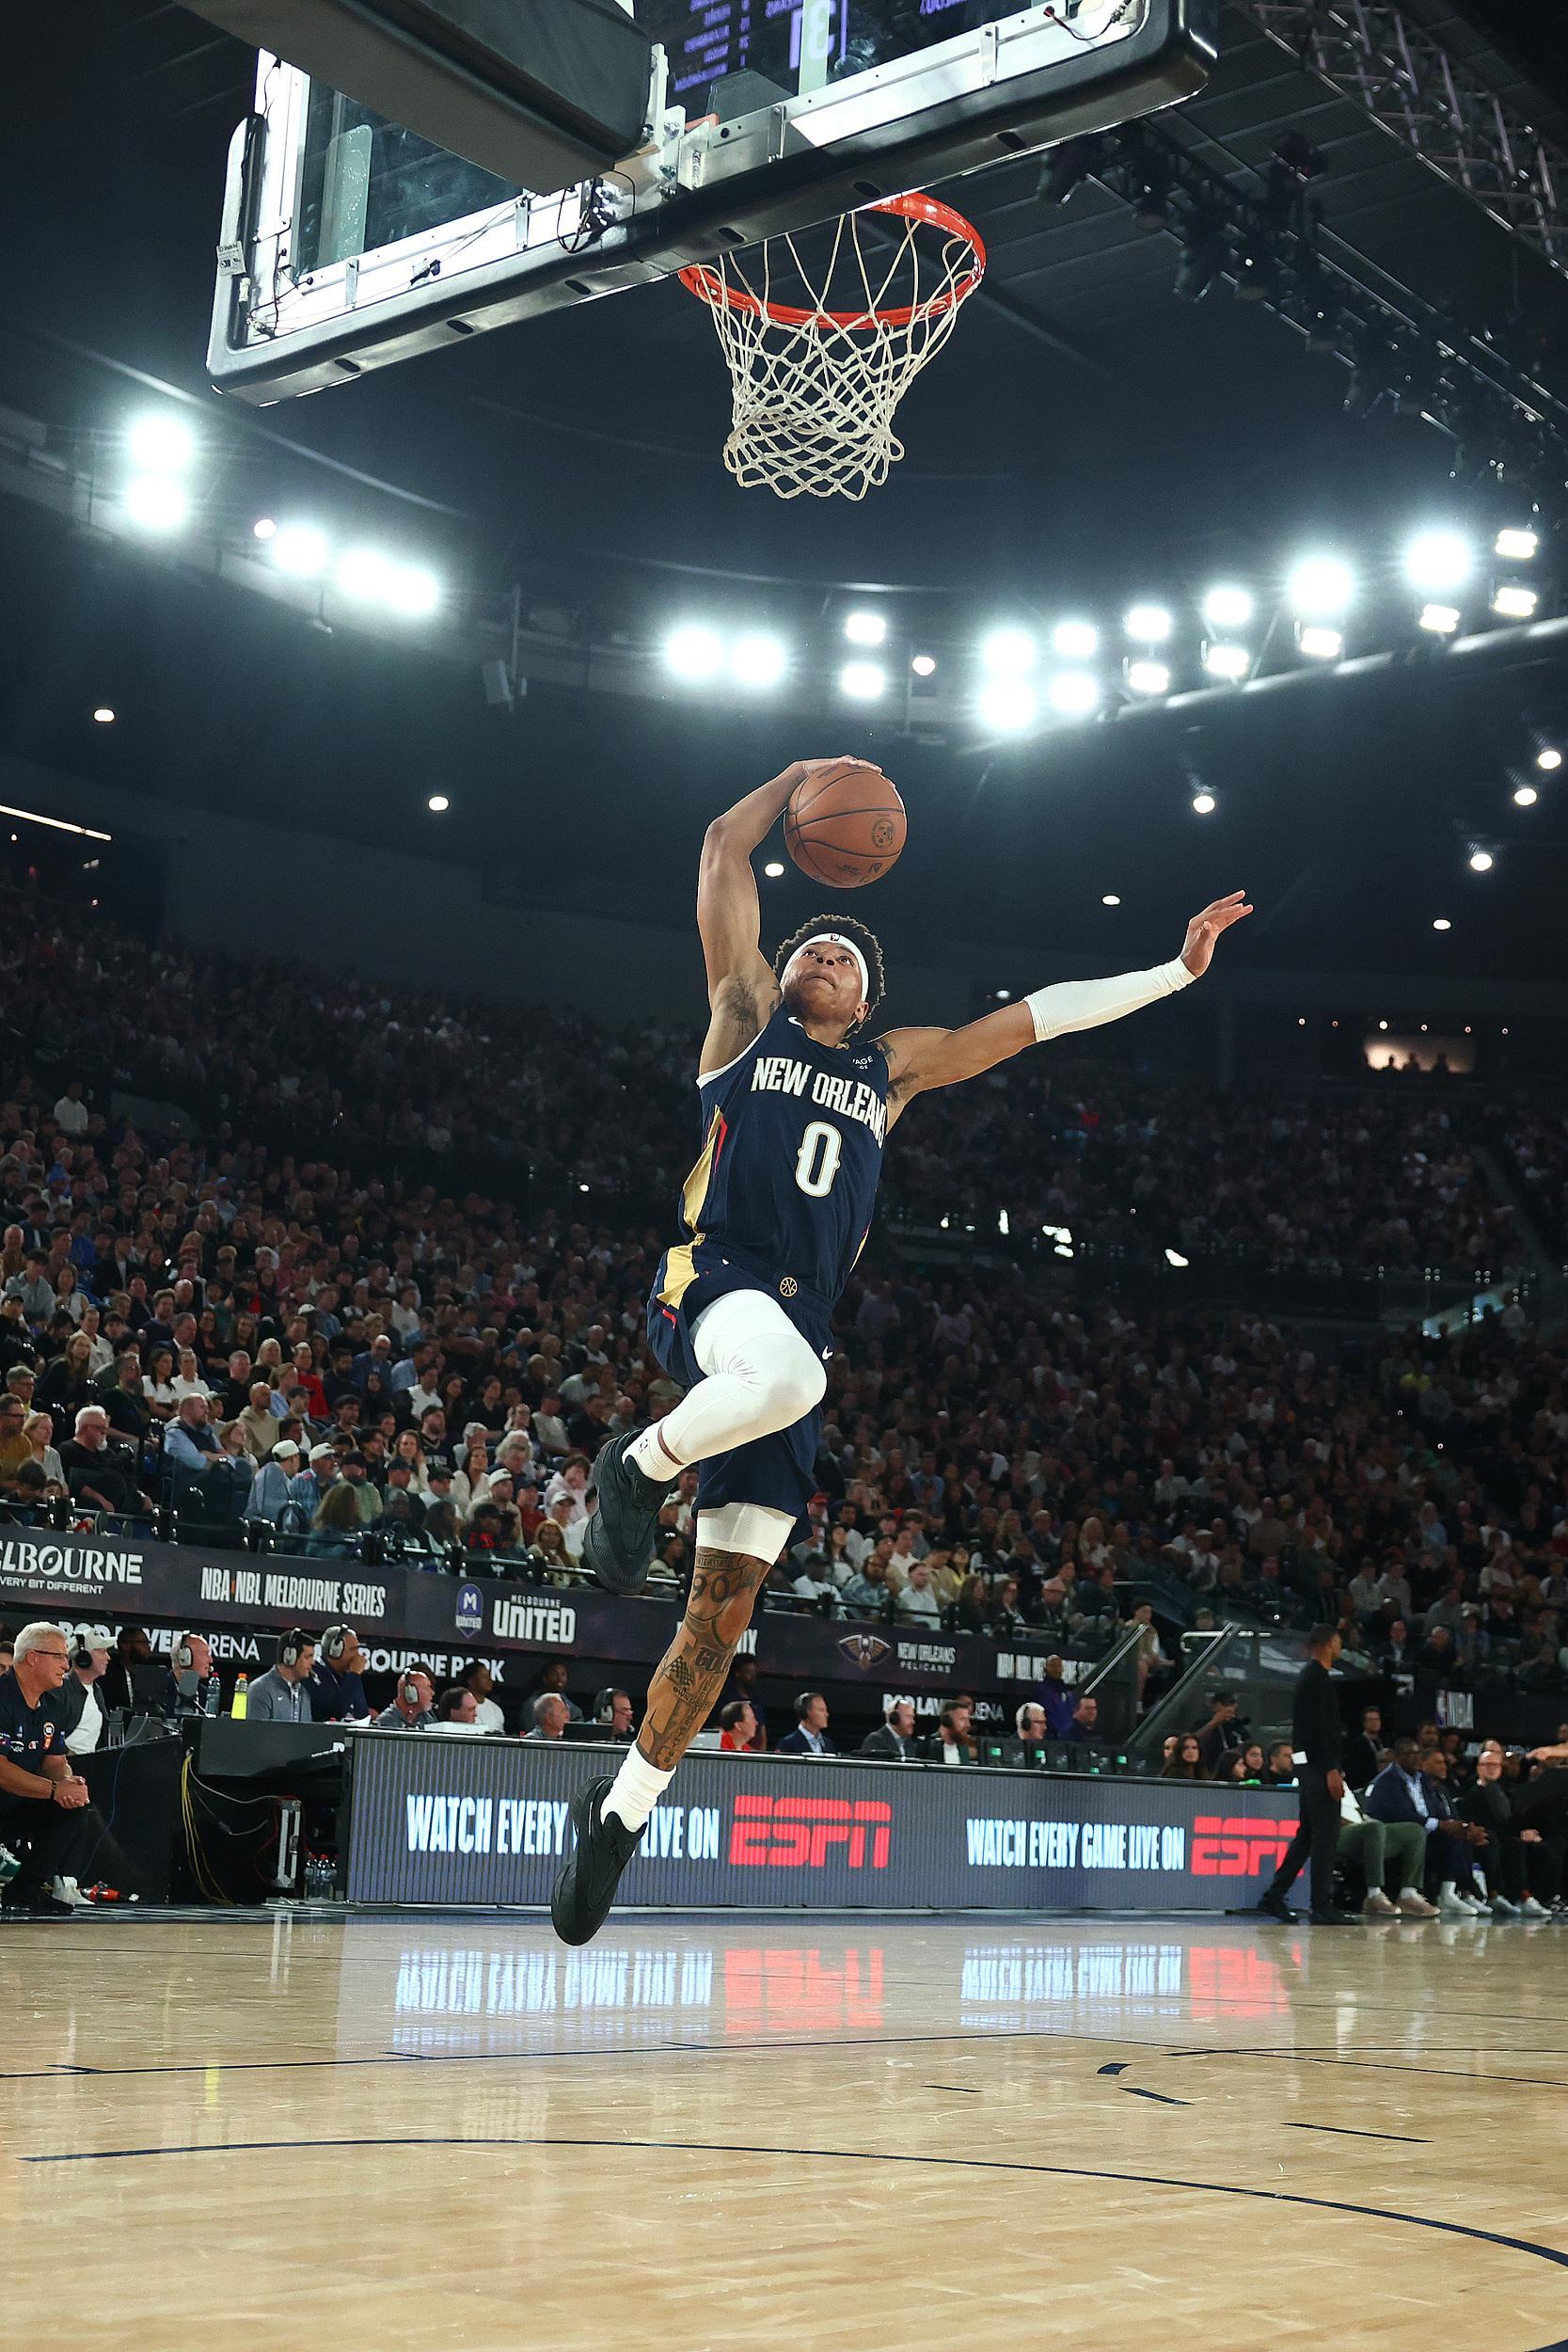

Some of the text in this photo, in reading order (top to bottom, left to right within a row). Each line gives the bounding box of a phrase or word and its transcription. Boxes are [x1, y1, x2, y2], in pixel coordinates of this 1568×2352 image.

[750, 1057, 813, 1097] NEW
[852, 1055, 874, 1065] AGE
[795, 1121, 842, 1198] 0
[0, 1540, 143, 1584] LBOURNE
[28, 1579, 45, 1589] BIT
[47, 1581, 104, 1595] DIFFERENT
[200, 1566, 387, 1617] NBA NBL MELBOURNE SERIES
[511, 1594, 562, 1609] MELBOURNE
[492, 1599, 577, 1644] UNITED
[200, 1633, 260, 1661] RENA
[451, 1656, 505, 1682] PK
[406, 1794, 492, 1853] WATCH
[497, 1799, 569, 1855] EVERY
[641, 1805, 685, 1858] LIVE
[688, 1806, 720, 1859] ON
[729, 1795, 893, 1868] ESPN
[966, 1819, 1027, 1867] WATCH
[1029, 1821, 1080, 1867] EVERY
[1082, 1822, 1127, 1869] GAME
[1129, 1825, 1161, 1870] LIVE
[1162, 1826, 1185, 1870] ON
